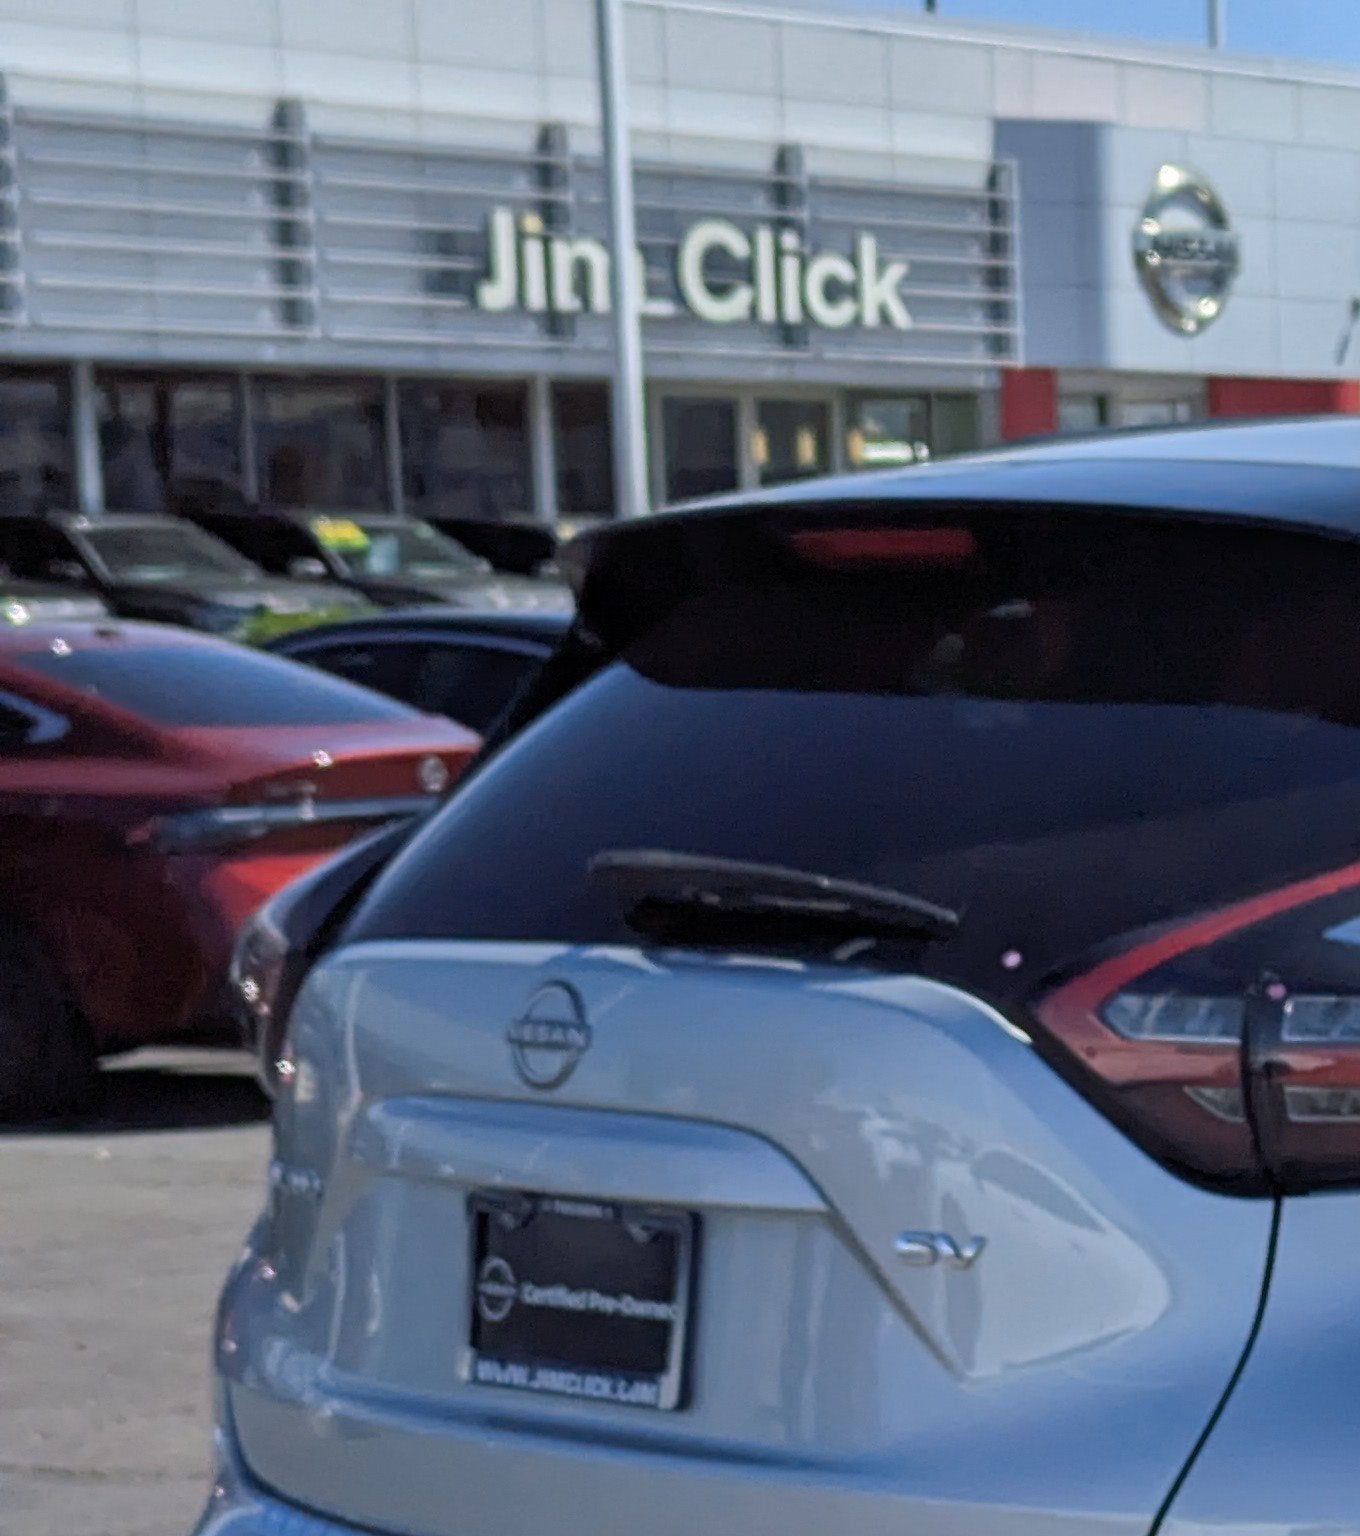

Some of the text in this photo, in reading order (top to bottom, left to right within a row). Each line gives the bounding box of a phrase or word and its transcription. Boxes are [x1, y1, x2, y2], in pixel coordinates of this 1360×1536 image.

[475, 207, 913, 330] Jim Click
[894, 1230, 987, 1272] SV
